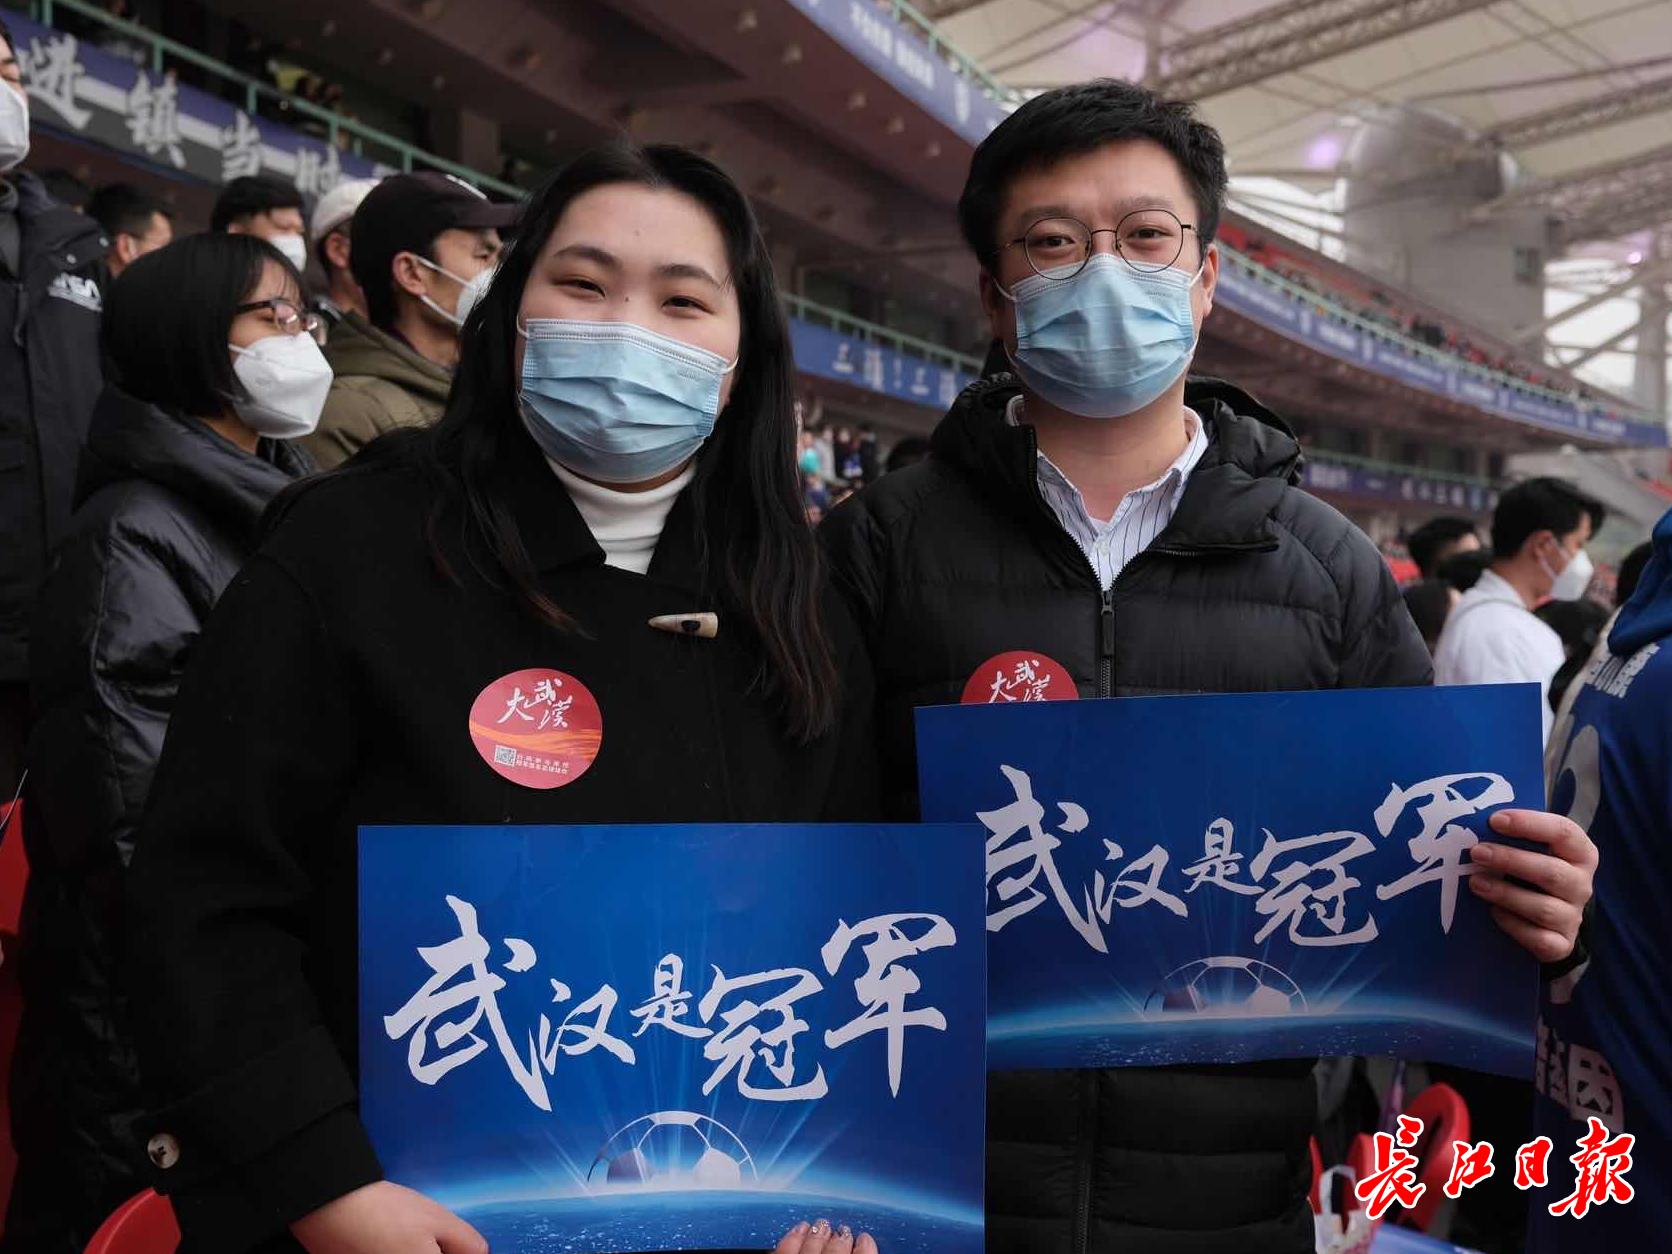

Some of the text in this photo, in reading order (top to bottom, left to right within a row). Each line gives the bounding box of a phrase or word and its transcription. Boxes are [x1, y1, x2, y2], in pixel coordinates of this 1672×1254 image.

[975, 764, 1515, 953] 武汉是冠军
[383, 895, 958, 1111] 武汉是冠军
